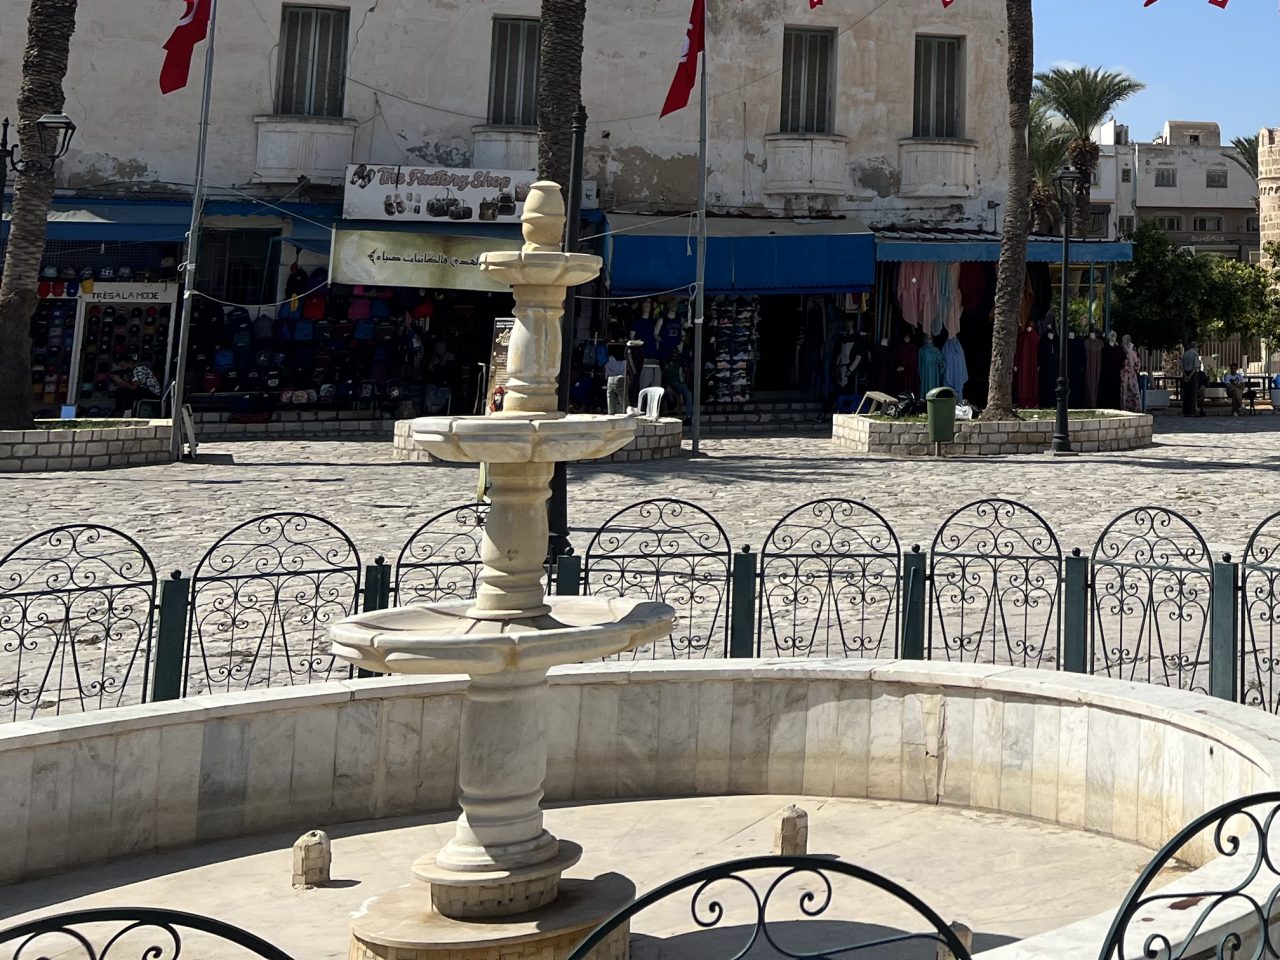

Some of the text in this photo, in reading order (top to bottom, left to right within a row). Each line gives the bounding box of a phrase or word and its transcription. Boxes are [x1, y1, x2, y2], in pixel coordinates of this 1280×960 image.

[377, 166, 511, 191] The Factory Shop
[136, 292, 159, 300] MODE
